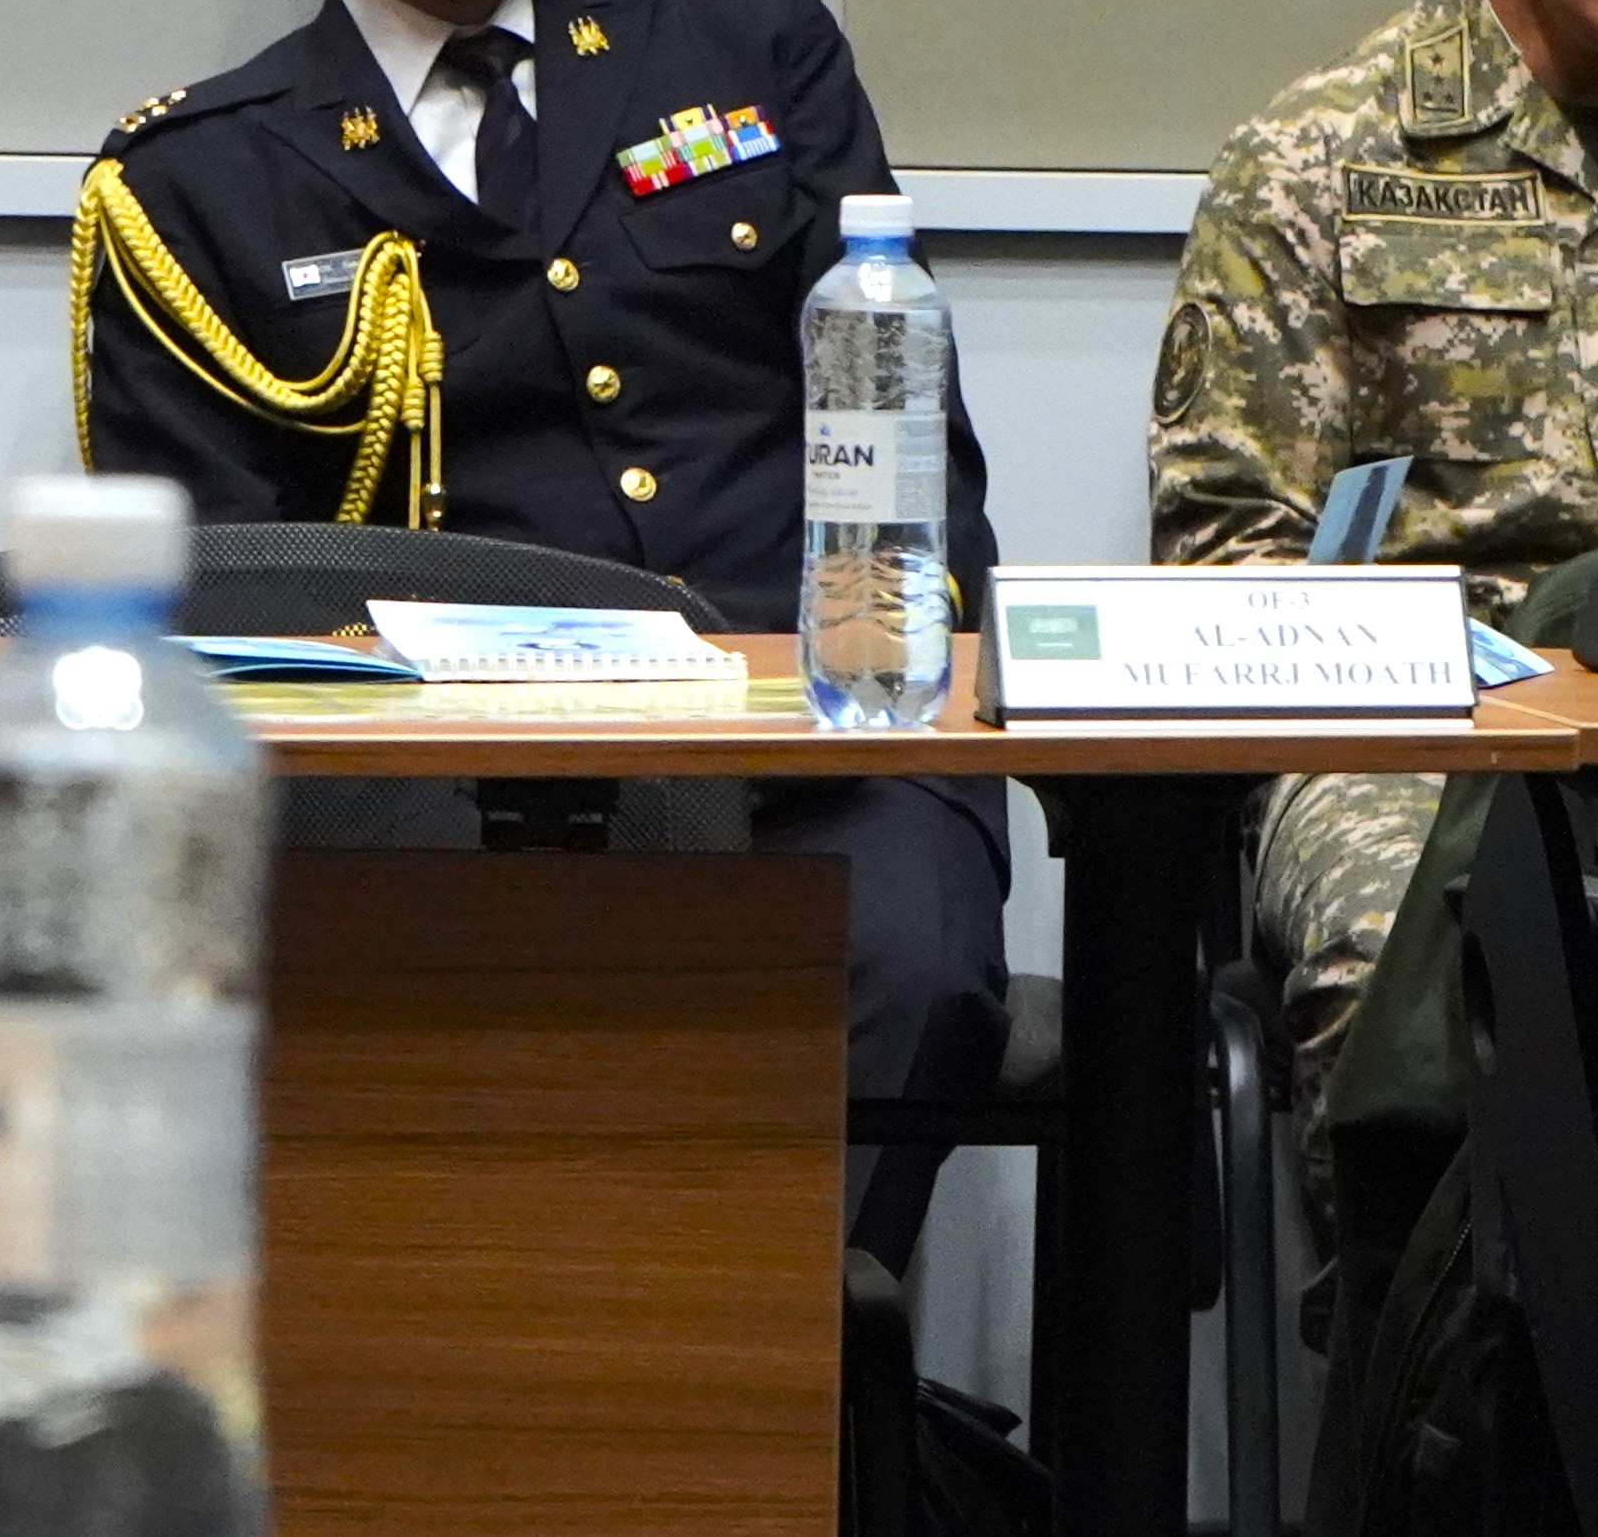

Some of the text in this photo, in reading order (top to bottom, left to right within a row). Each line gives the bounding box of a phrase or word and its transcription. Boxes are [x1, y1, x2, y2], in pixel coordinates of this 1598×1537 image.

[1247, 590, 1311, 610] OF-3
[1190, 624, 1381, 647] AL-ADNAN
[1314, 661, 1452, 685] MOATH
